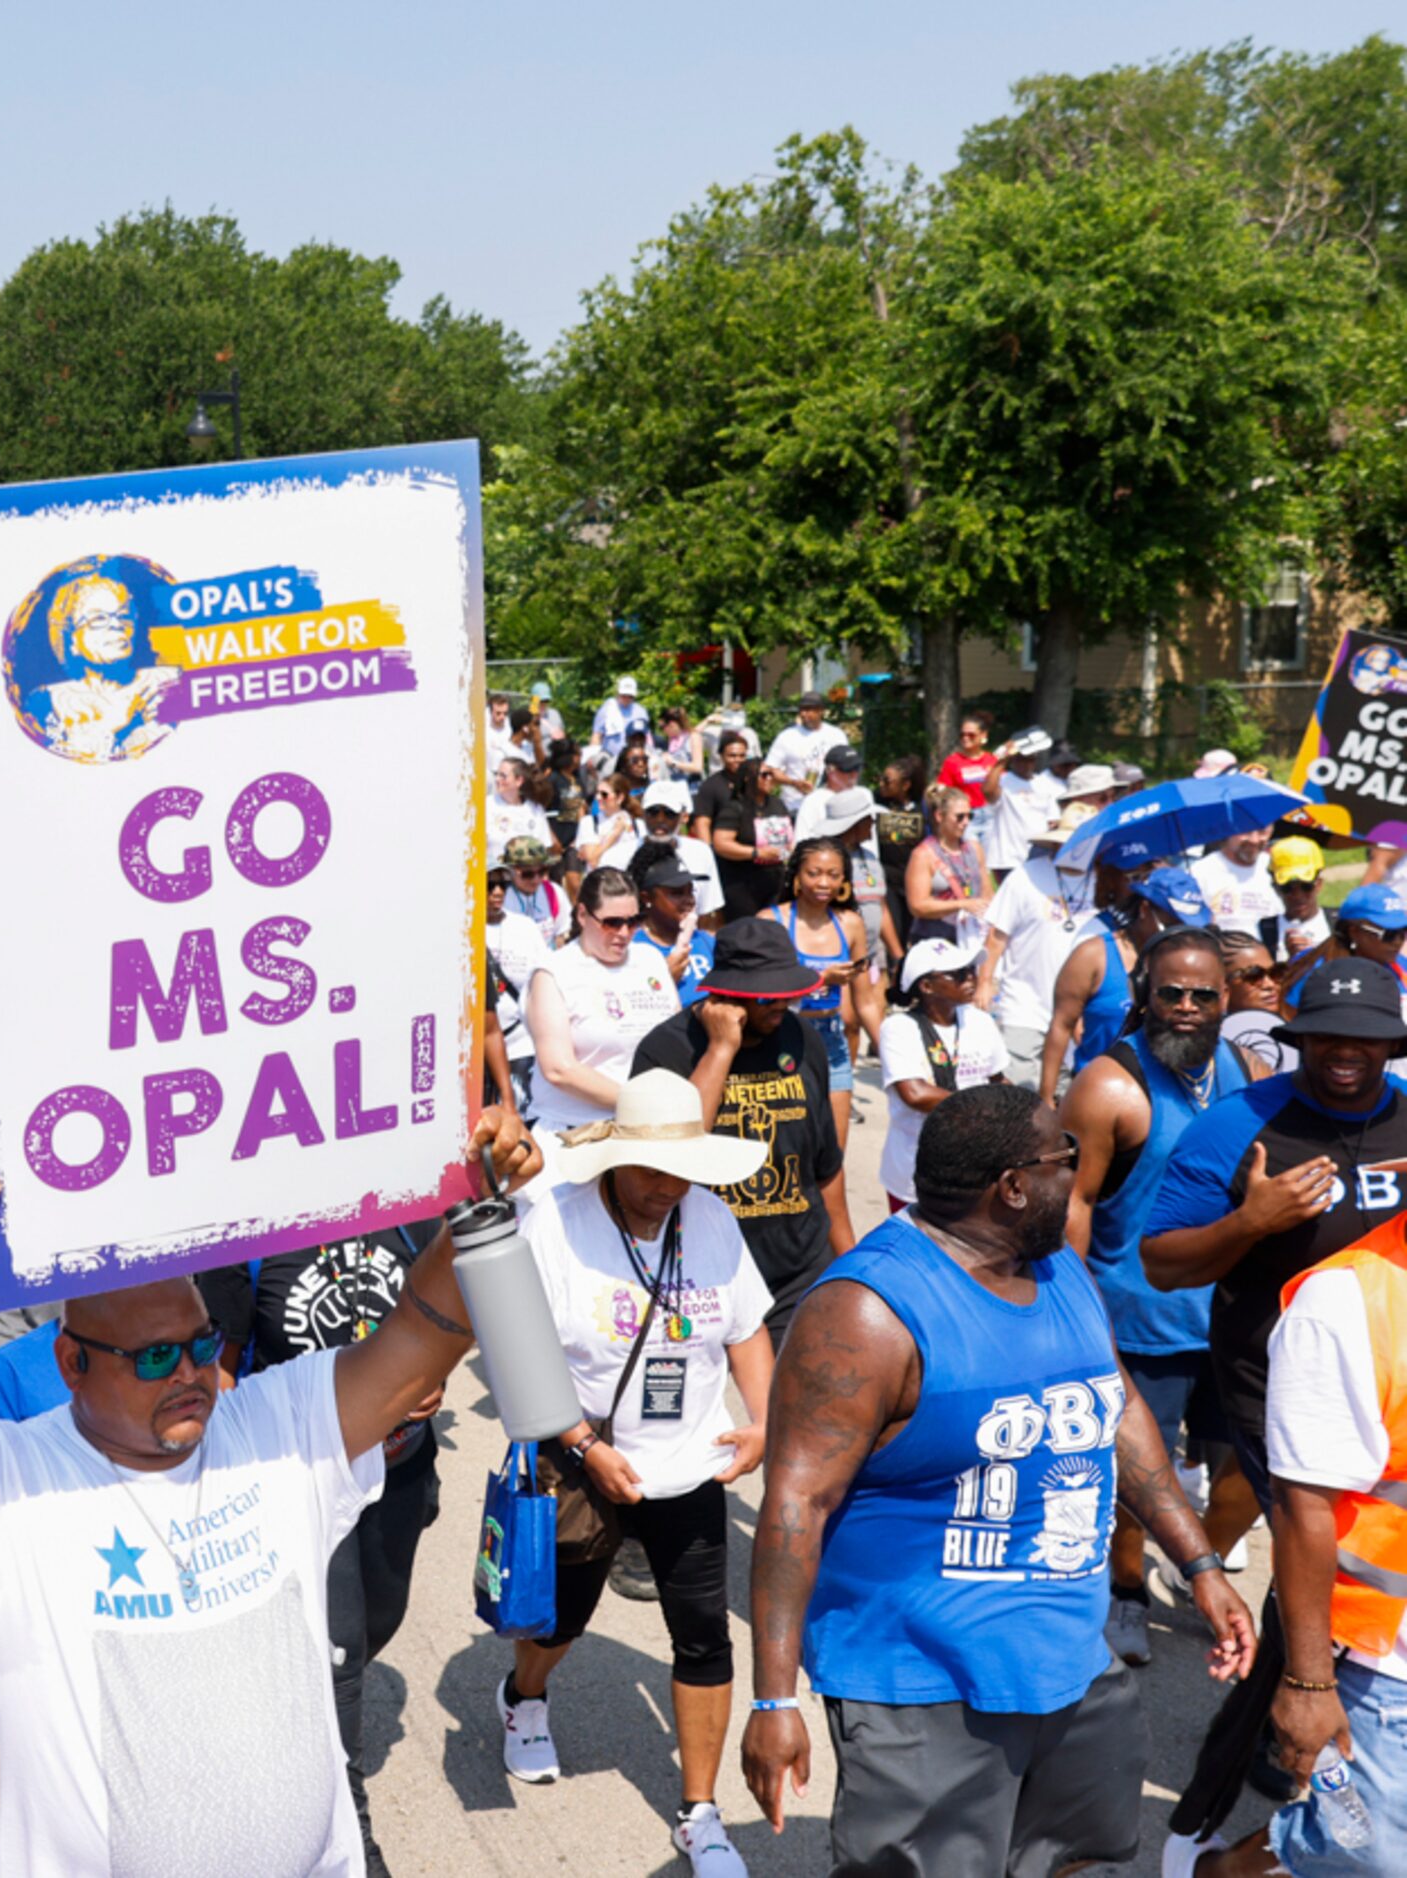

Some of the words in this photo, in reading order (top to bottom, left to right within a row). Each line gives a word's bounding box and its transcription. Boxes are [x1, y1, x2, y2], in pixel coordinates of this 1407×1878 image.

[170, 577, 294, 620] OPAL'S
[185, 623, 287, 664] WALK
[298, 615, 368, 651] FOR
[190, 656, 380, 708] FREEDOM
[119, 772, 331, 903] GO
[109, 915, 357, 1050] MS.
[24, 1015, 436, 1192] OPAL!
[953, 1462, 1018, 1522] 19
[943, 1527, 1011, 1568] BLUE
[94, 1589, 174, 1620] AMU
